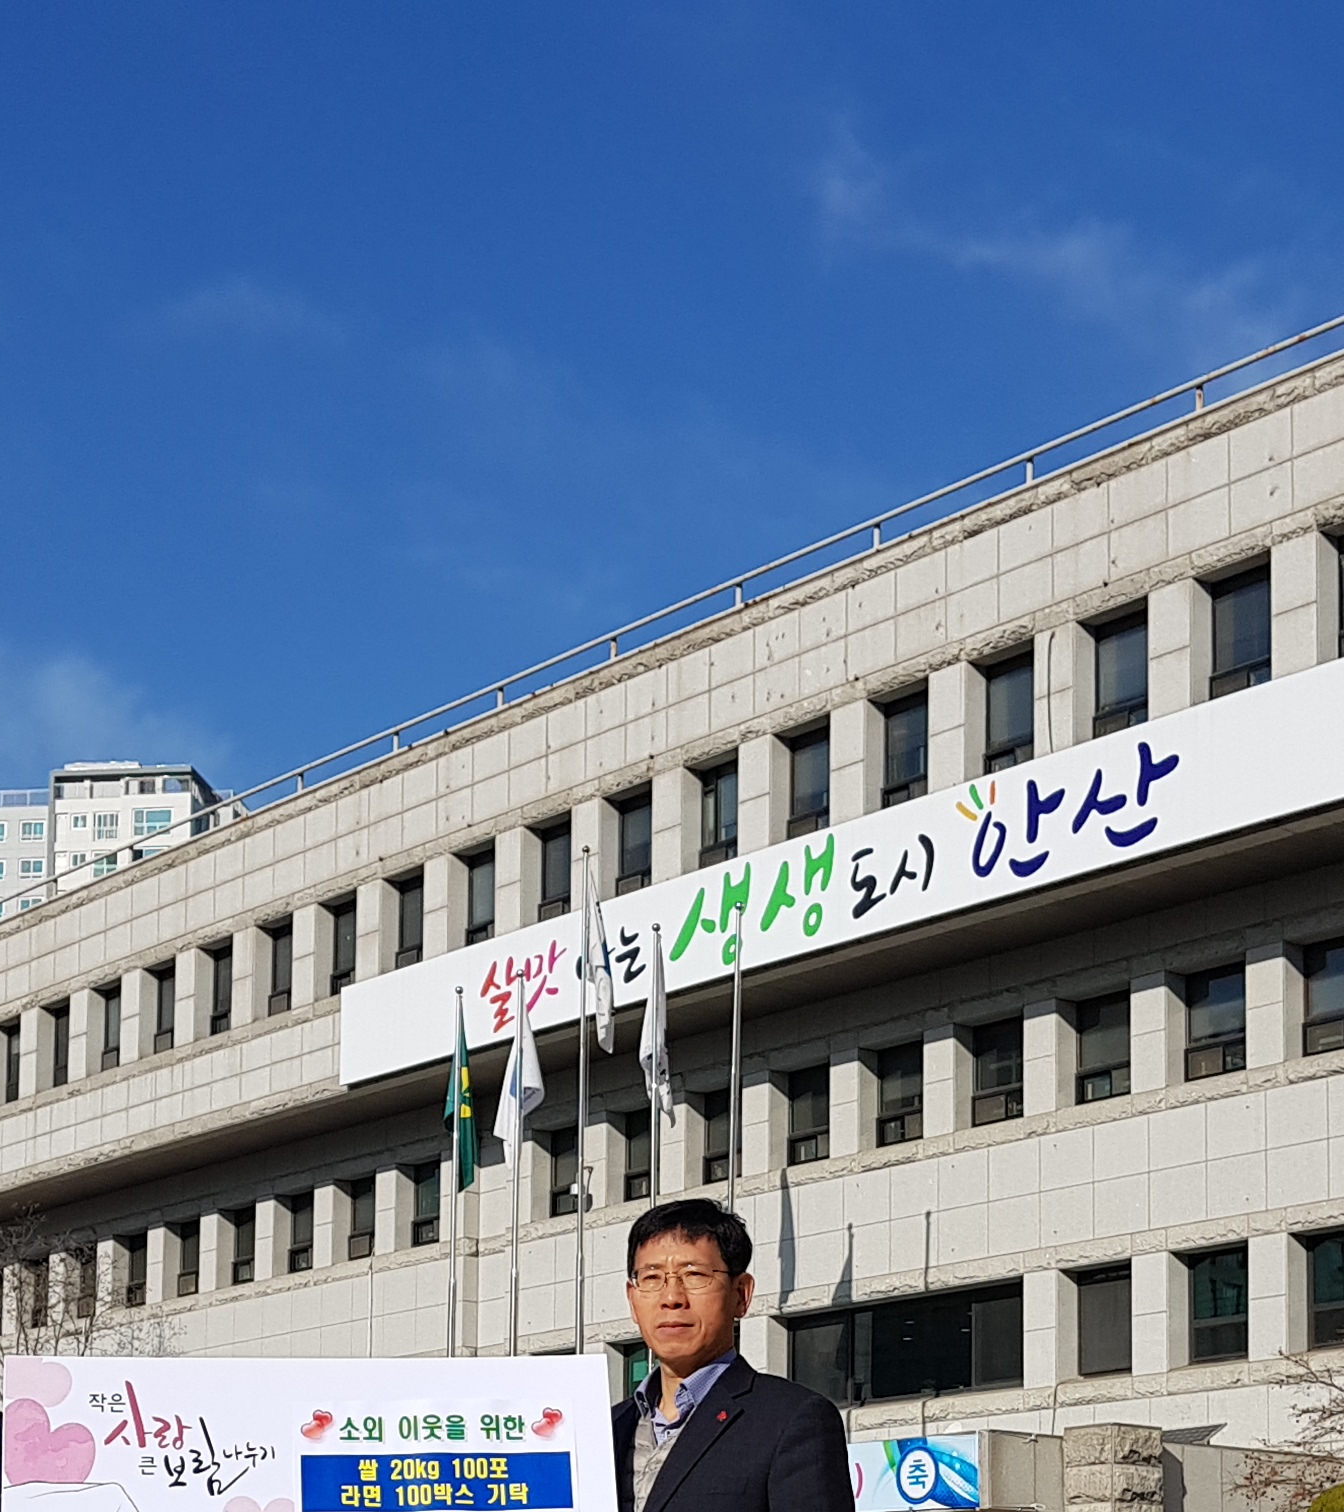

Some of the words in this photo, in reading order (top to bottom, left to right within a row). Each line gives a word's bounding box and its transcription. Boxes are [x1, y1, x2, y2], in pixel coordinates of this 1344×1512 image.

[972, 742, 1179, 877] 안산
[88, 1393, 126, 1413] 작은
[104, 1380, 192, 1449] 사랑
[339, 1416, 384, 1442] 소외
[398, 1414, 466, 1441] 이웃을
[480, 1414, 525, 1441] 위한
[138, 1456, 157, 1475] 큰
[358, 1459, 378, 1481] 쌀
[390, 1459, 440, 1481] 20kg
[452, 1458, 509, 1480] 100포
[907, 1459, 928, 1489] 축
[341, 1485, 382, 1507] 라면
[395, 1483, 474, 1507] 100박스
[487, 1482, 529, 1505] 기탁
